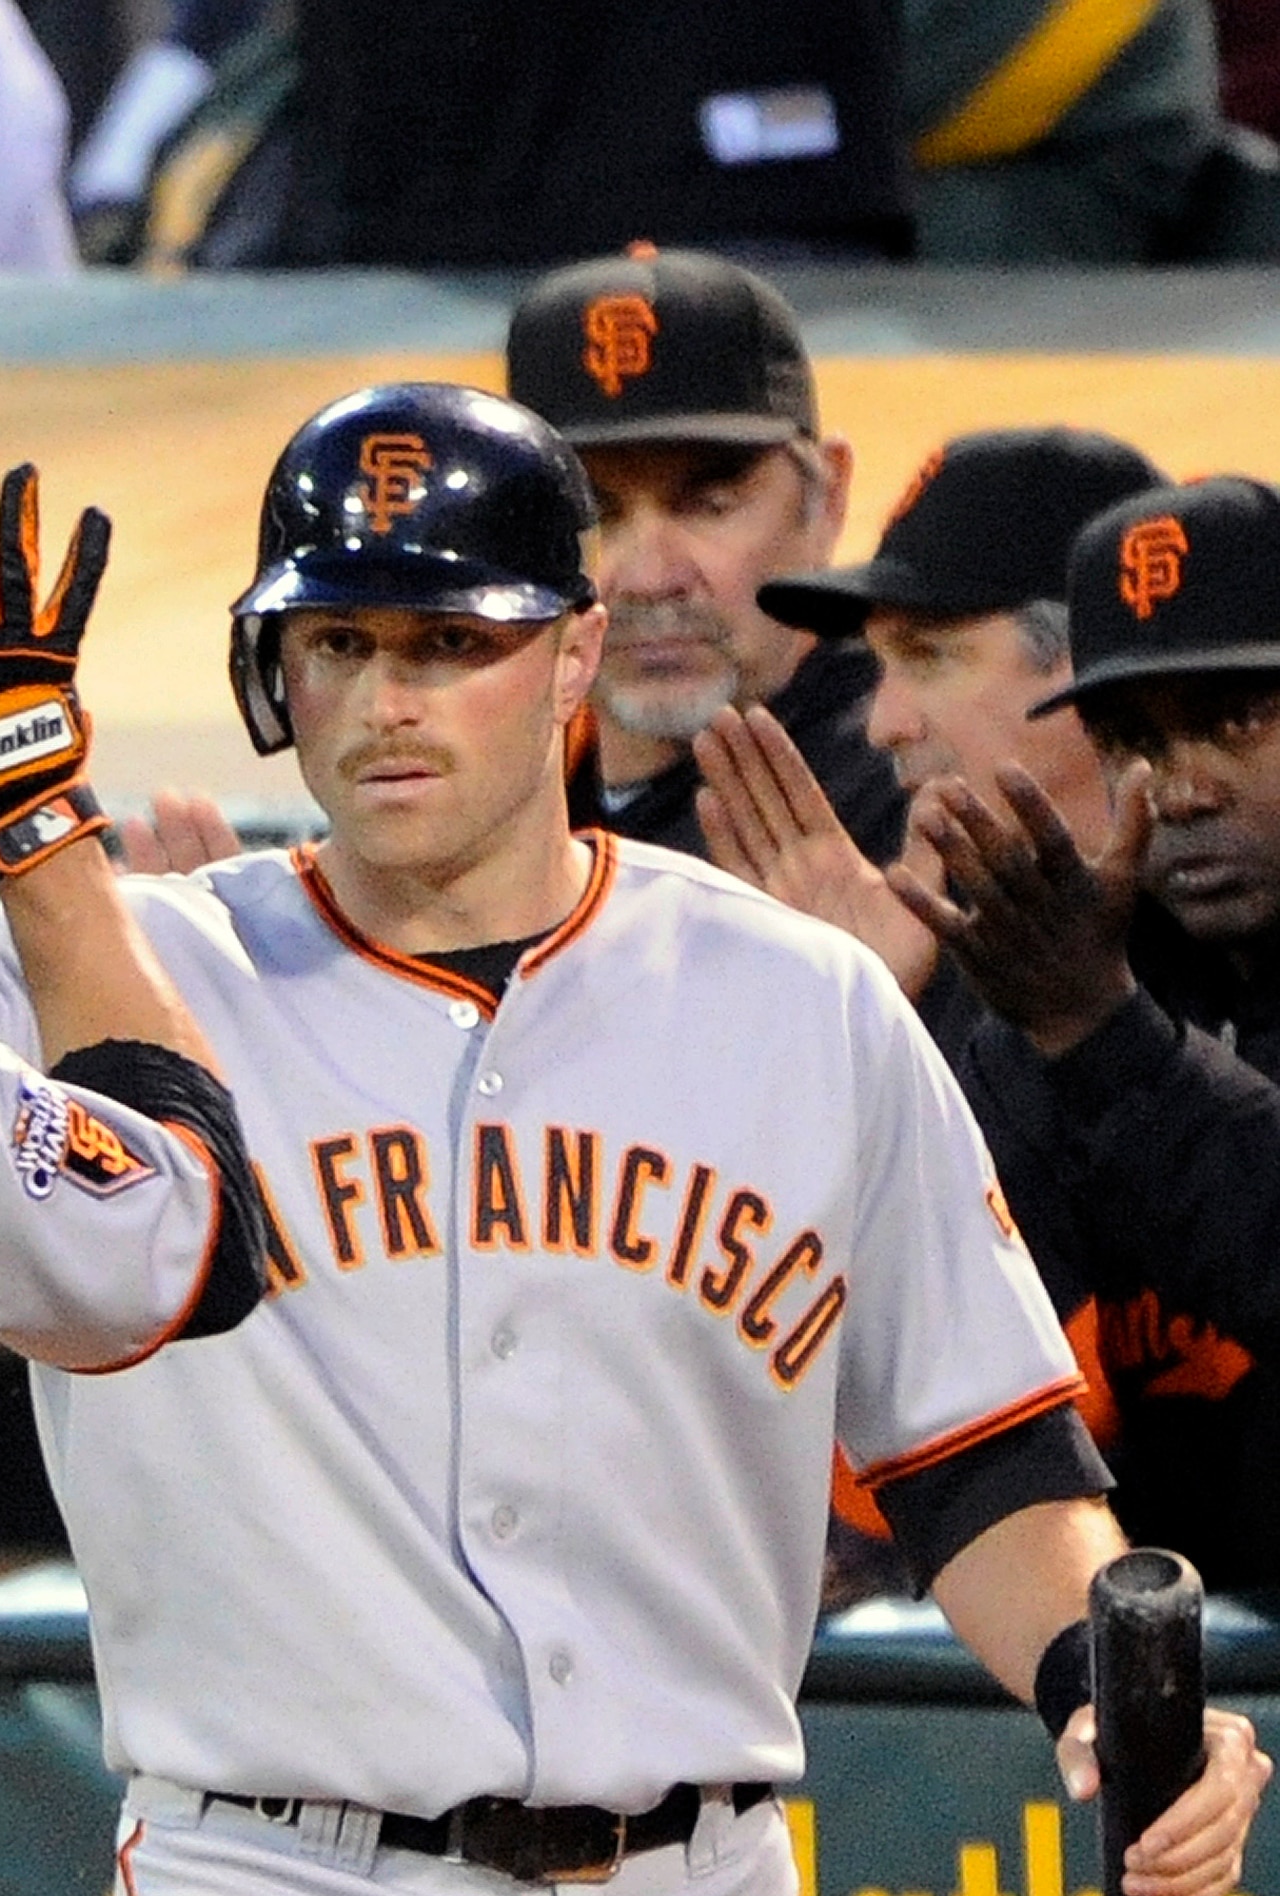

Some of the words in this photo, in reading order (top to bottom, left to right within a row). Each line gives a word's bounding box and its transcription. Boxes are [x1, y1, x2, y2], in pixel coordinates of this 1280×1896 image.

[582, 294, 659, 398] SF
[361, 432, 433, 535] SF
[1120, 514, 1188, 620] SF
[308, 1121, 850, 1394] FRANCISCO
